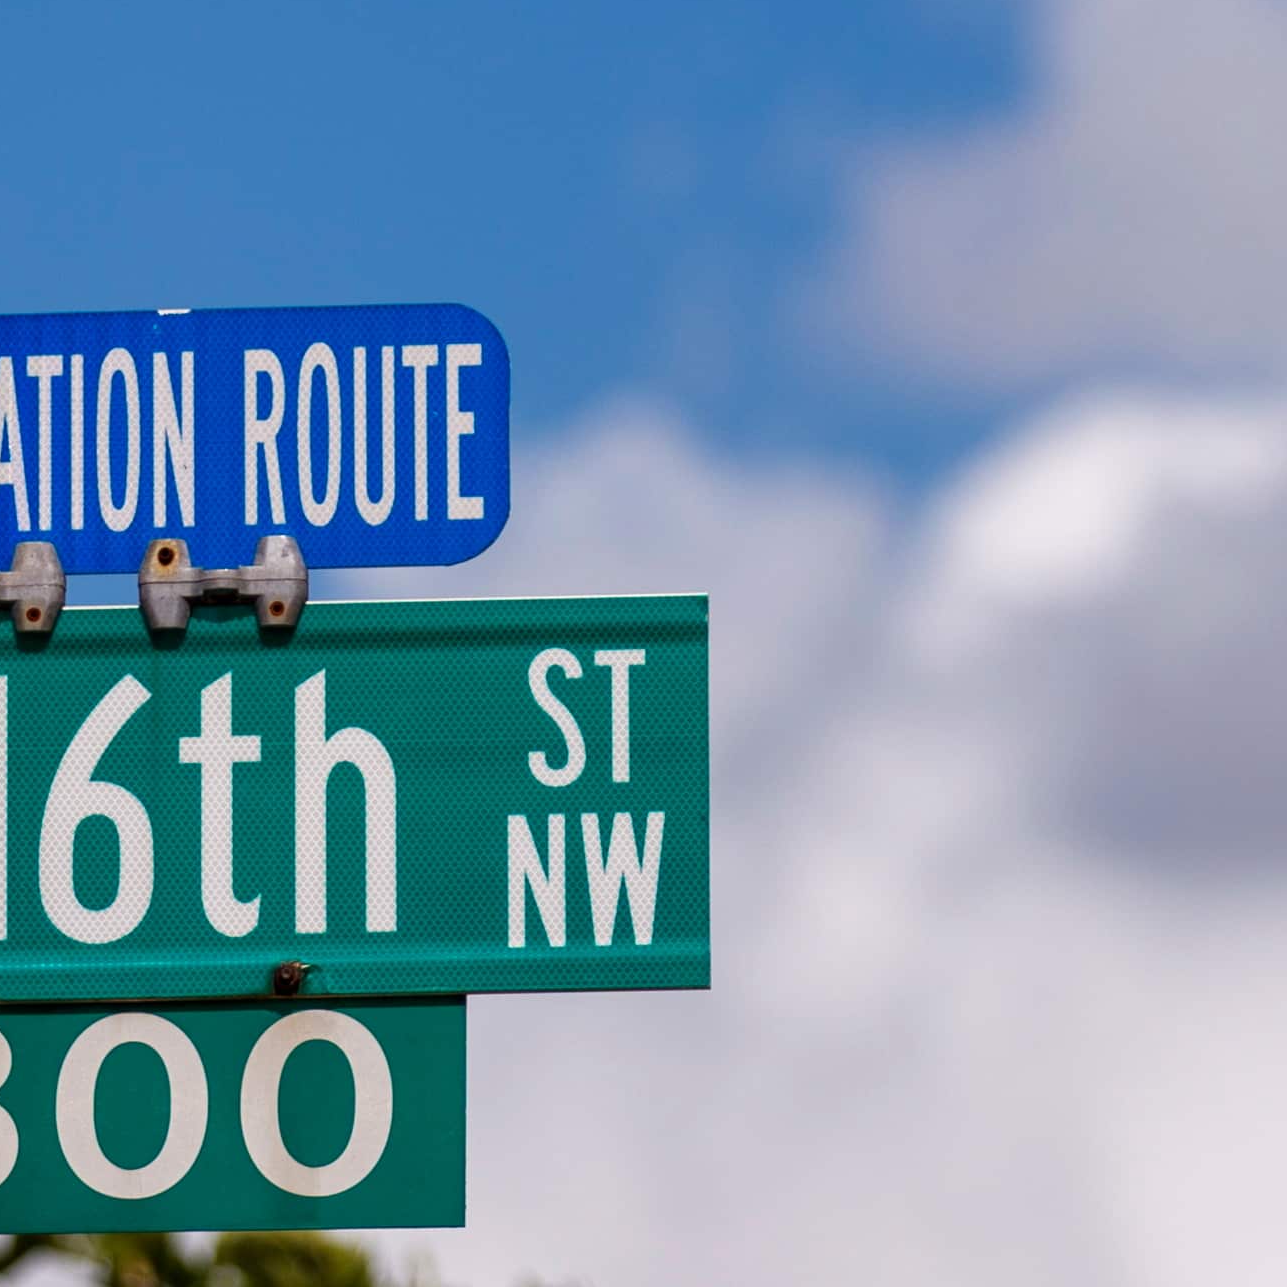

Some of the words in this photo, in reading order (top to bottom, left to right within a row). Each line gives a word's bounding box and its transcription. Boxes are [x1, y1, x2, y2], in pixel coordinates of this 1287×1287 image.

[245, 343, 483, 526] ROUTE
[529, 649, 645, 787] ST
[508, 812, 664, 947] NW
